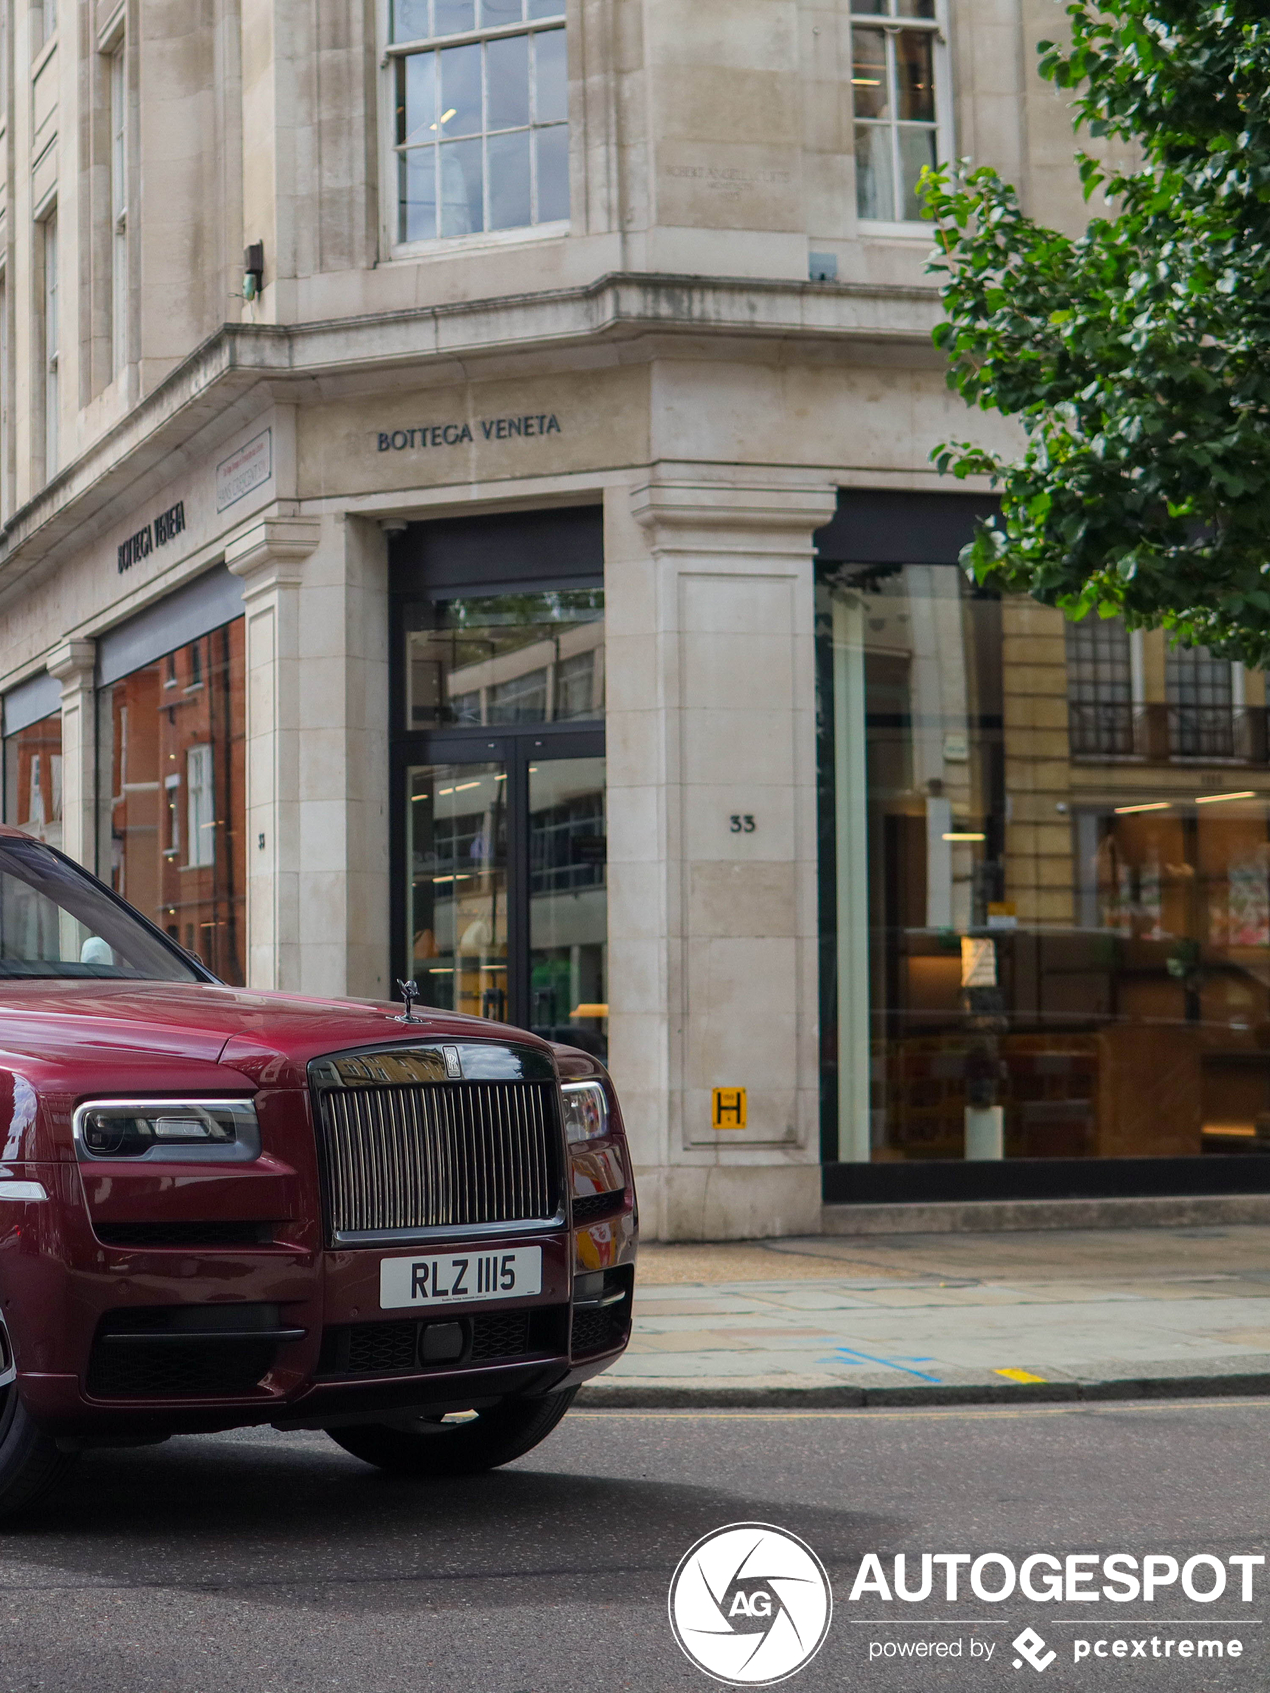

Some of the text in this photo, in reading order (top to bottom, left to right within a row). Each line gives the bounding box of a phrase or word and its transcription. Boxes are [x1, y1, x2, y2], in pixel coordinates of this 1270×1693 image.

[377, 414, 561, 452] BOTTEGA VENETA
[730, 815, 755, 833] 33
[716, 1092, 741, 1124] H
[411, 1255, 516, 1299] RLZ 1115
